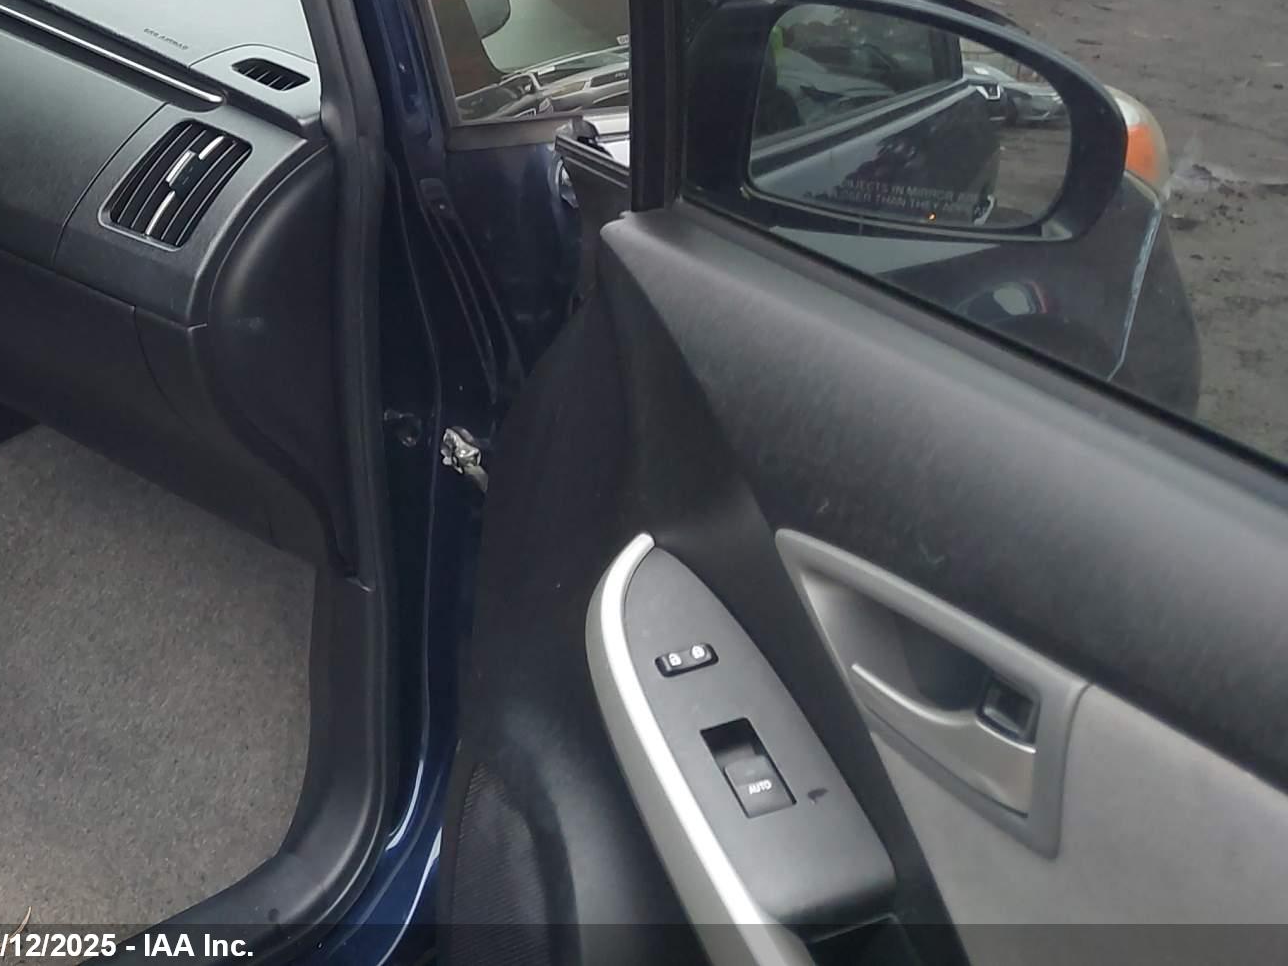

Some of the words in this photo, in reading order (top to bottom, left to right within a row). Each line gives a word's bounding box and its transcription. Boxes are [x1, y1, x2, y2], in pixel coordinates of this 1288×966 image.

[891, 184, 905, 195] IN
[907, 185, 954, 201] MIRROR
[875, 193, 906, 208] THAN
[910, 198, 940, 210] THEY
[748, 779, 772, 795] AUTO
